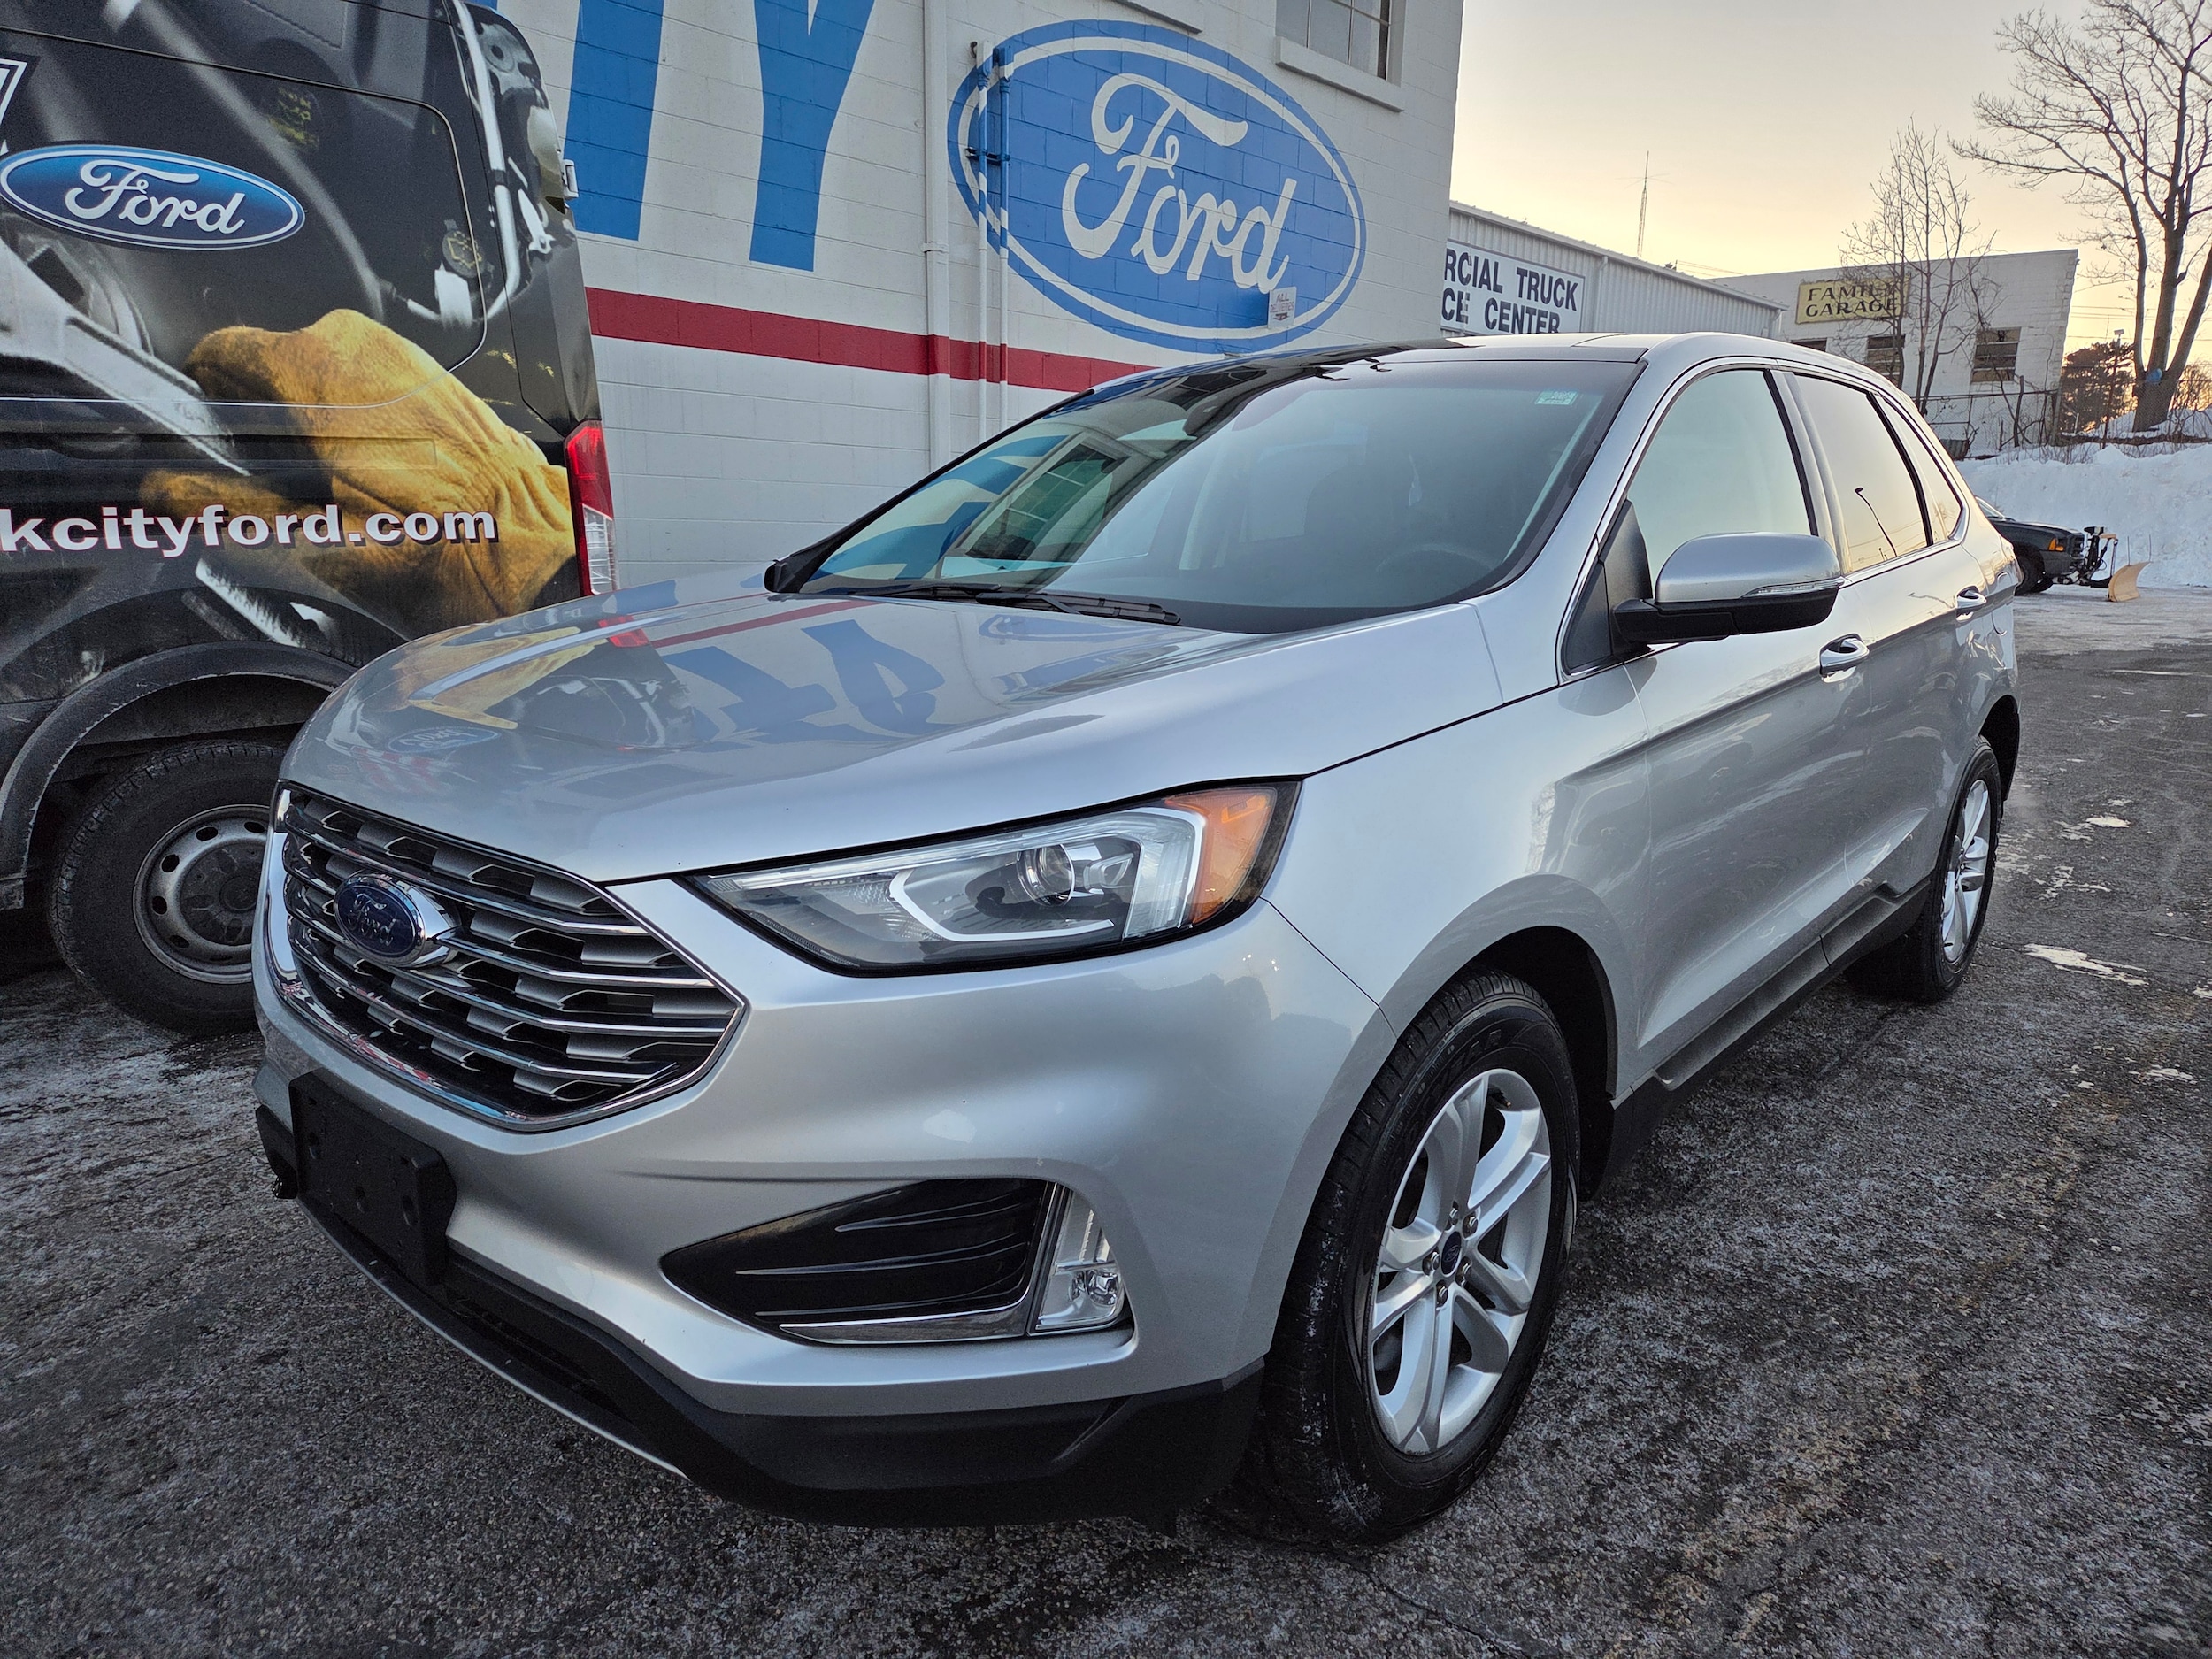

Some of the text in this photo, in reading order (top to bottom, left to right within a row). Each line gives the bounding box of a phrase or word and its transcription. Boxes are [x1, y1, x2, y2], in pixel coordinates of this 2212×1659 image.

[65, 159, 246, 234] Ford
[1063, 73, 1297, 293] Ford
[1444, 249, 1578, 311] RCIAL TRUCK
[1806, 297, 1899, 318] GARAGE
[1485, 297, 1561, 334] CENTER
[0, 503, 496, 558] kcityford.com
[348, 893, 396, 946] Ford
